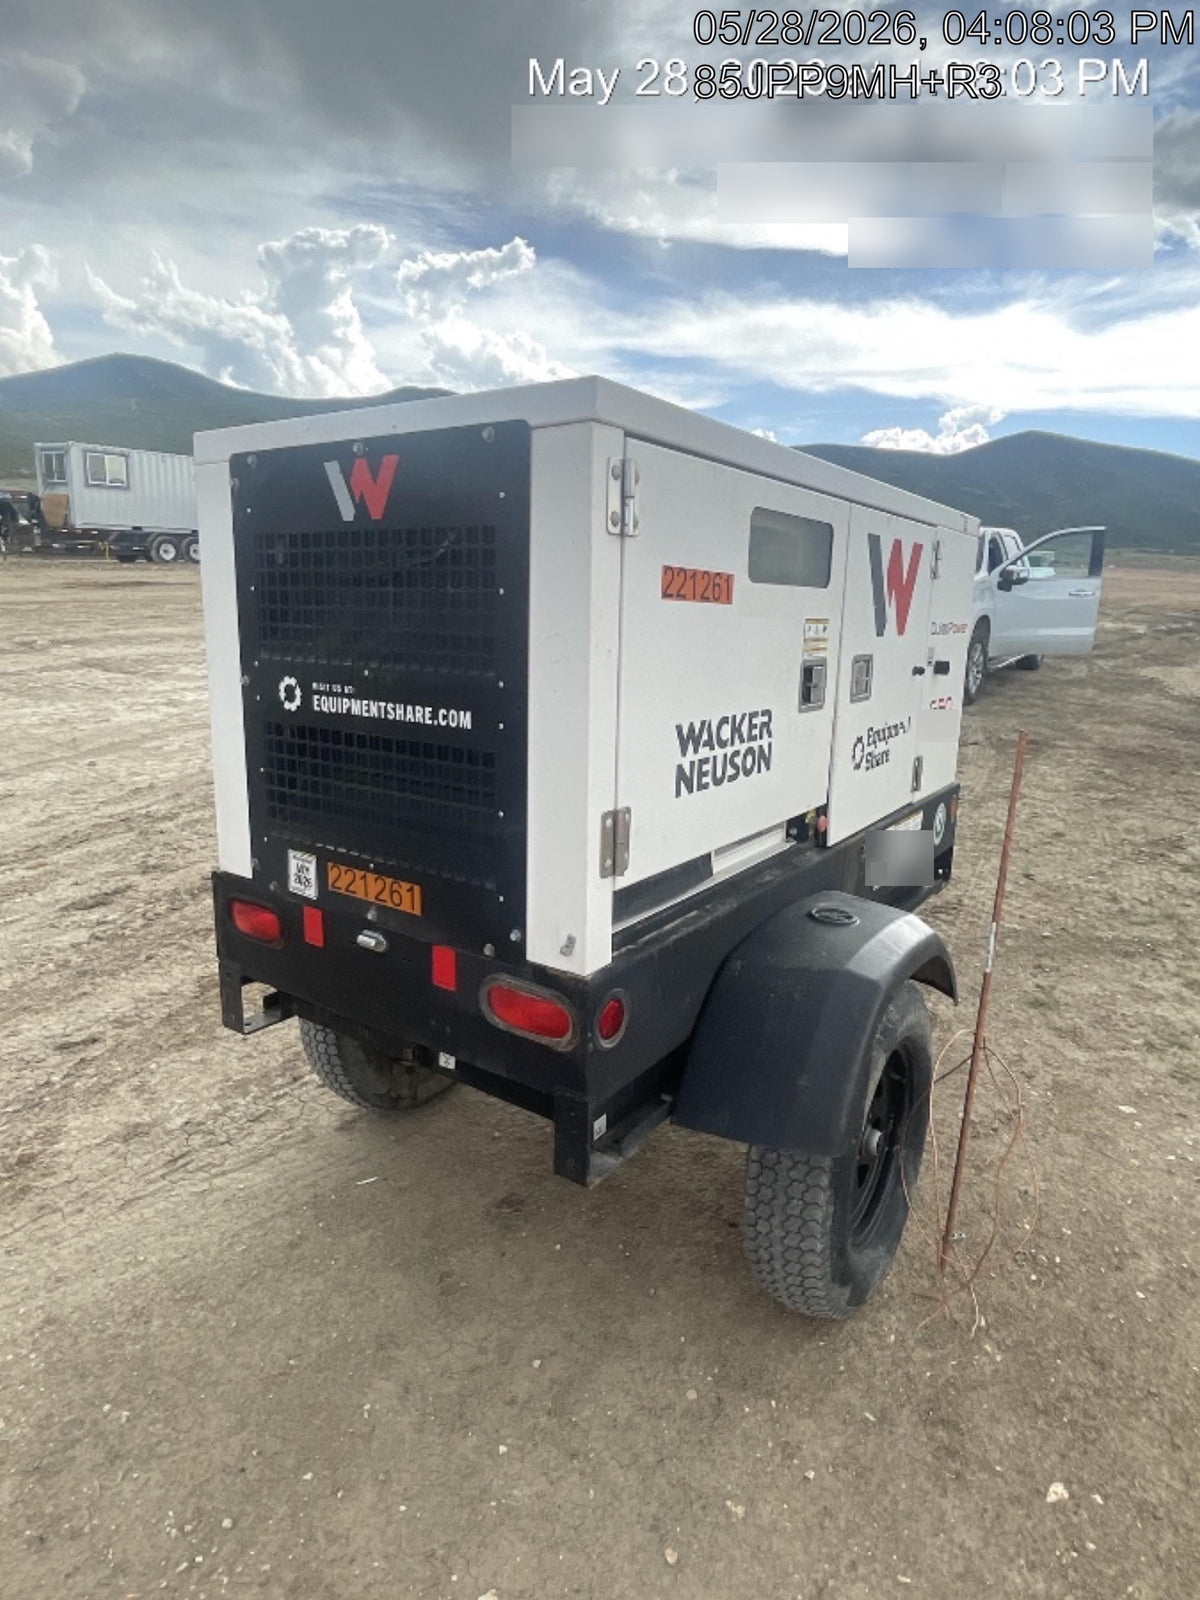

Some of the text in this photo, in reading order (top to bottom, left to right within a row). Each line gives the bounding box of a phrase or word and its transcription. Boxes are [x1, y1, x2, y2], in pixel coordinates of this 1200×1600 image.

[662, 566, 730, 602] 221261
[312, 694, 472, 730] EQUIPMENTSHARE.COM
[675, 708, 773, 758] WACKER
[675, 740, 773, 799] NEUSON
[329, 865, 417, 912] 221261
